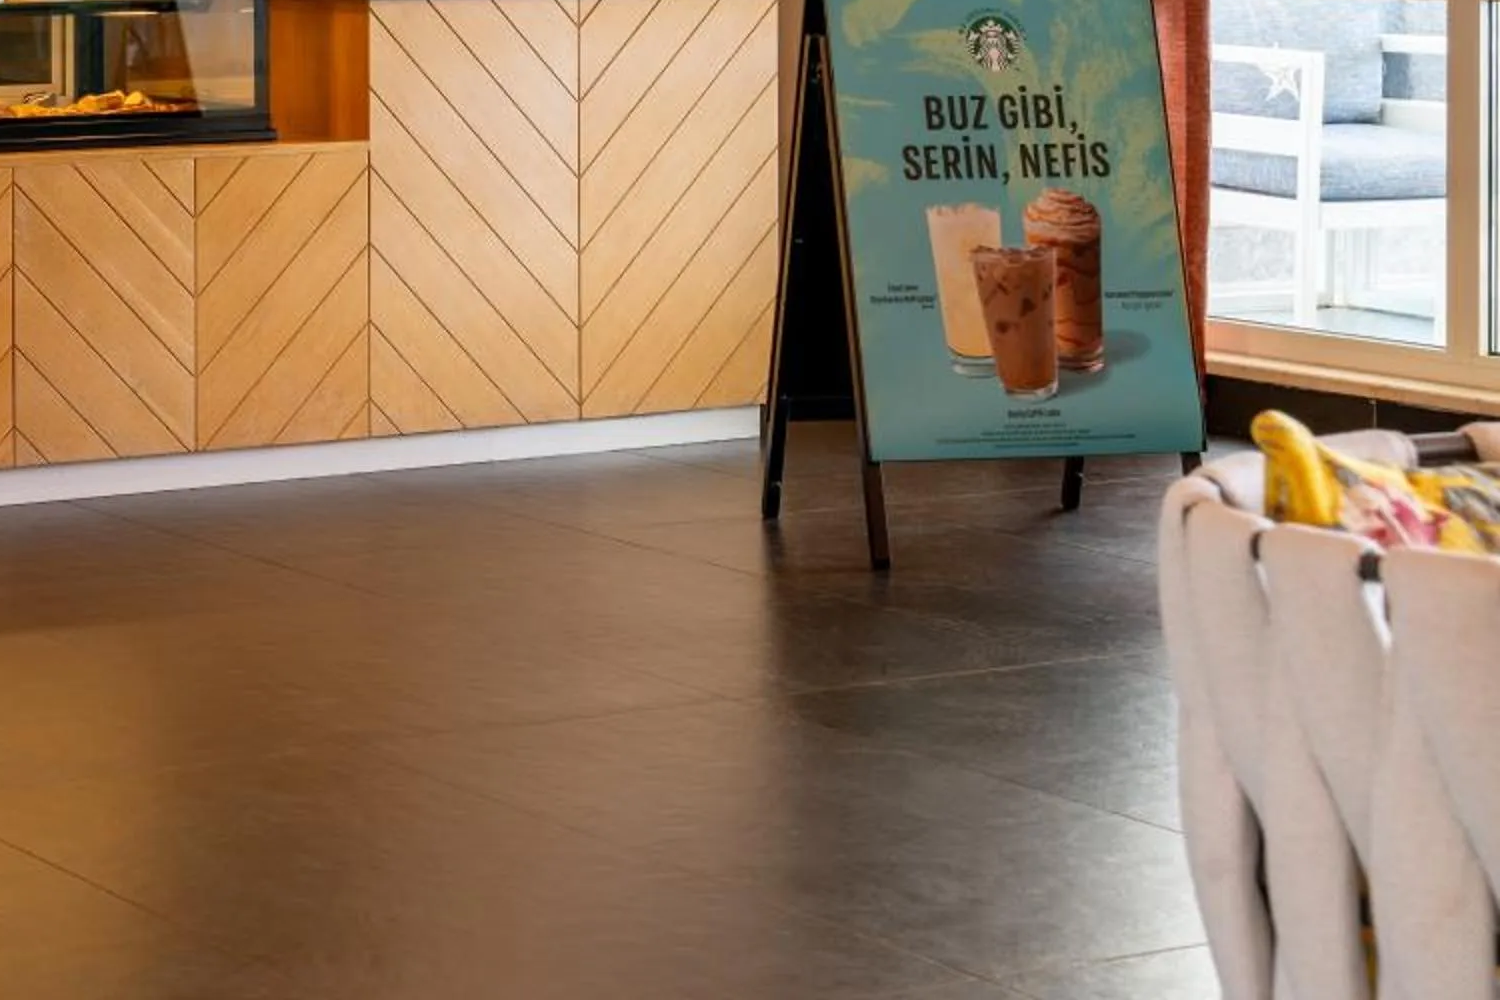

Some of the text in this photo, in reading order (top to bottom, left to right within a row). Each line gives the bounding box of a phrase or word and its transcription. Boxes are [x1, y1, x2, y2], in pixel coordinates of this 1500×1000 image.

[923, 85, 1078, 135] BUZ GİBİ,
[902, 133, 1111, 185] SERİN, NEFİS
